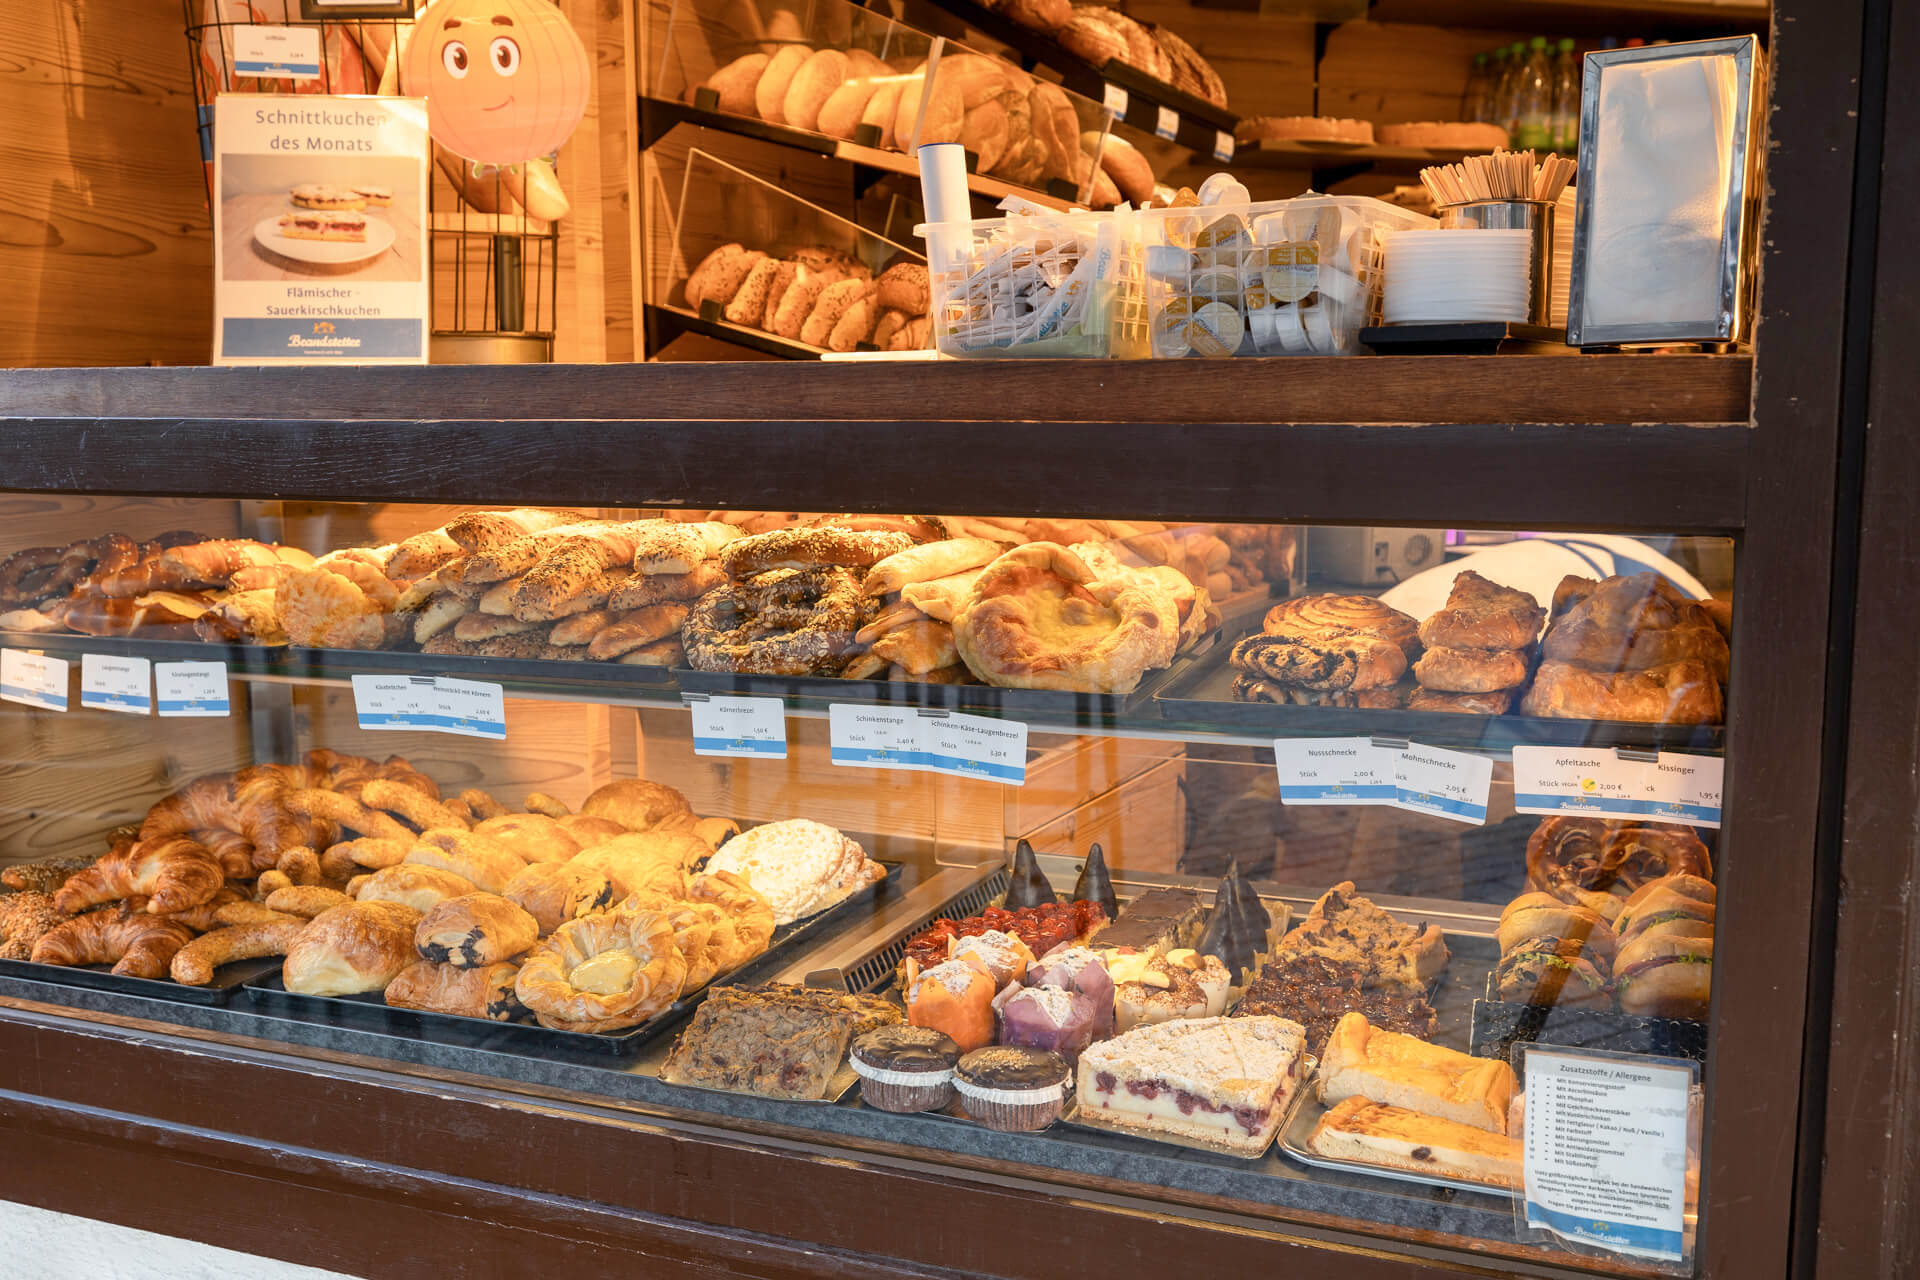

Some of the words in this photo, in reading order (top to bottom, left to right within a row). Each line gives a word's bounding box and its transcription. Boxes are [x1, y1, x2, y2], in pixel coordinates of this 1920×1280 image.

[256, 110, 387, 126] Schnittkuchen
[270, 136, 300, 150] des
[306, 136, 373, 151] Monats
[287, 288, 352, 298] Flämischer
[266, 305, 381, 316] Sauerkirschkuchen
[856, 715, 904, 725] Schinkenstange
[940, 741, 957, 749] Stück
[1308, 748, 1357, 756] Nussschnecke
[1401, 752, 1456, 770] Mohnschnecke
[1555, 759, 1601, 767] Apfeltasche
[1658, 764, 1696, 775] Kissinger
[1560, 1064, 1608, 1077] Zusatzstoffe
[1616, 1072, 1652, 1082] Allergene
